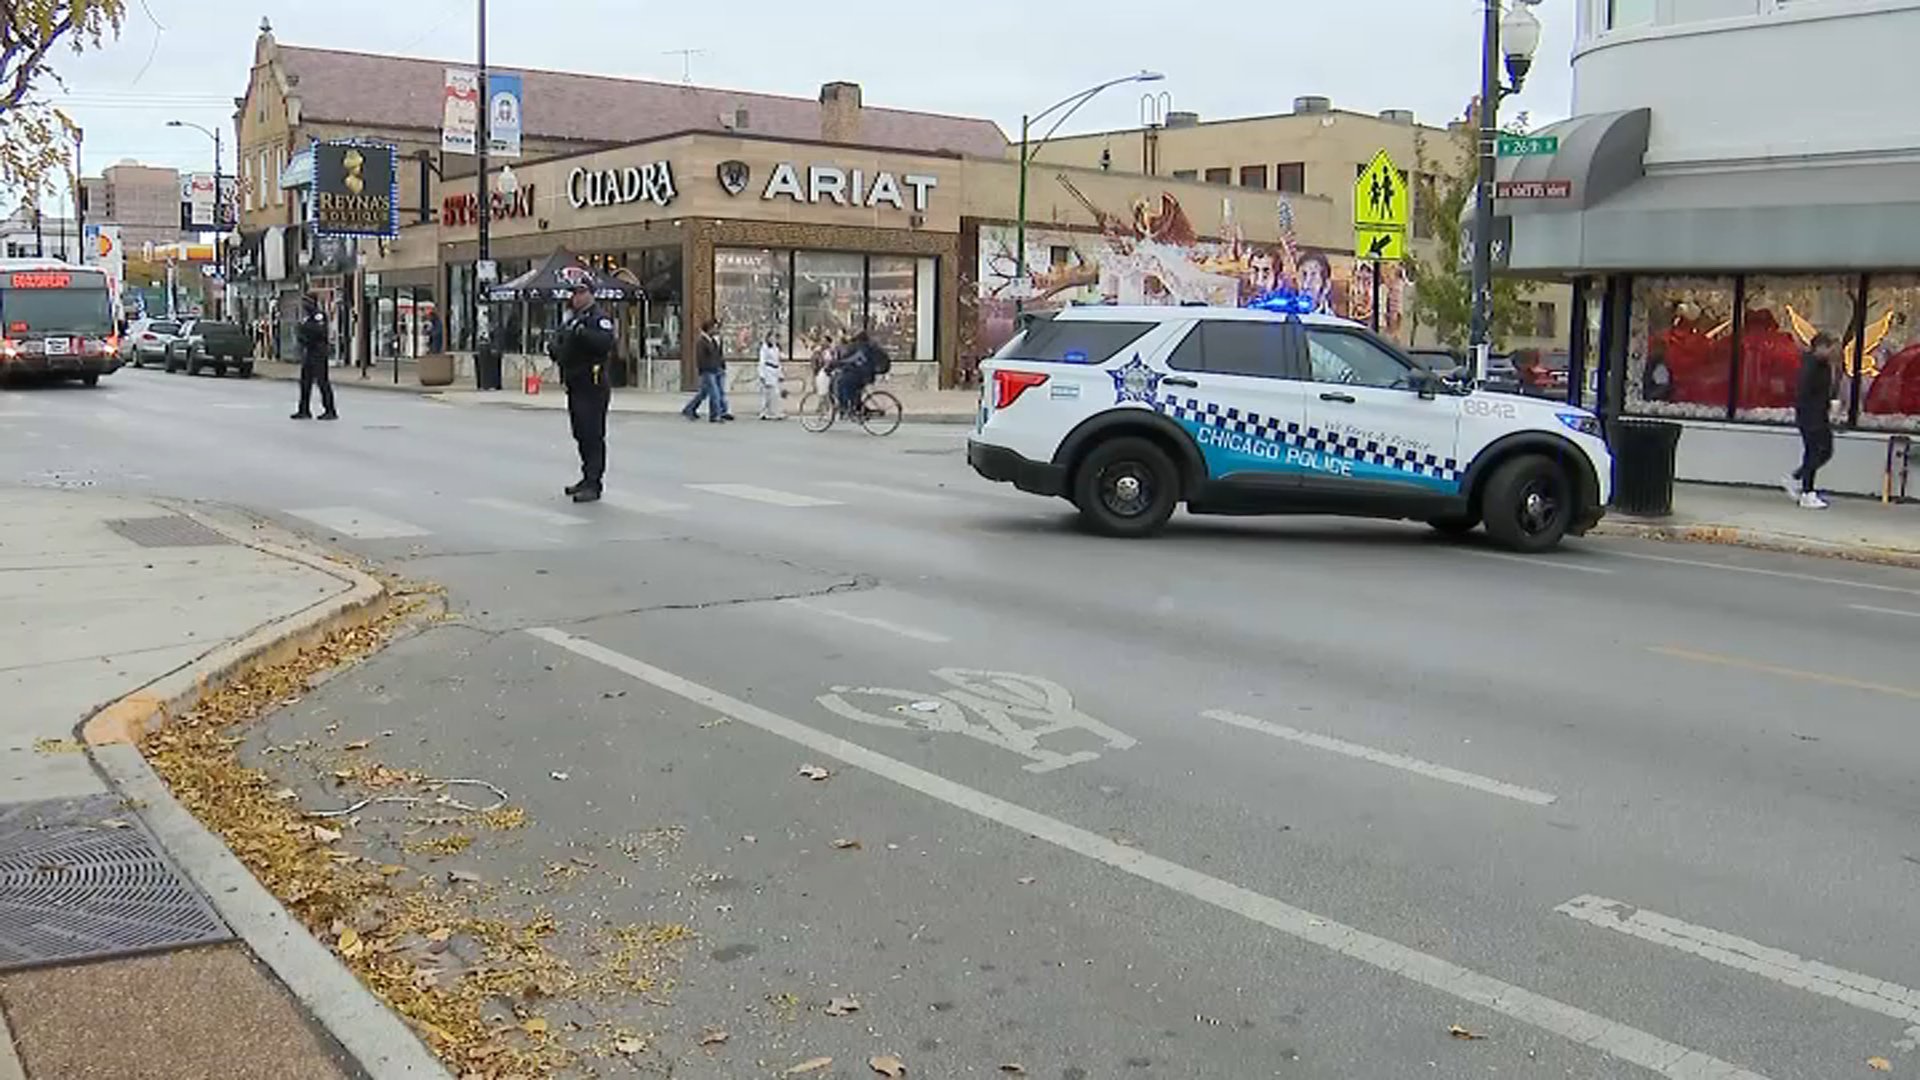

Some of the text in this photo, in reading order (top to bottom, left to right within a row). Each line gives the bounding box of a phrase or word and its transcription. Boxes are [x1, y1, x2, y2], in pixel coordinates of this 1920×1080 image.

[567, 160, 678, 208] CUADRA
[762, 160, 938, 212] ARIAT
[1463, 399, 1517, 419] 8842
[1196, 426, 1355, 478] CHICAGO POLICE
